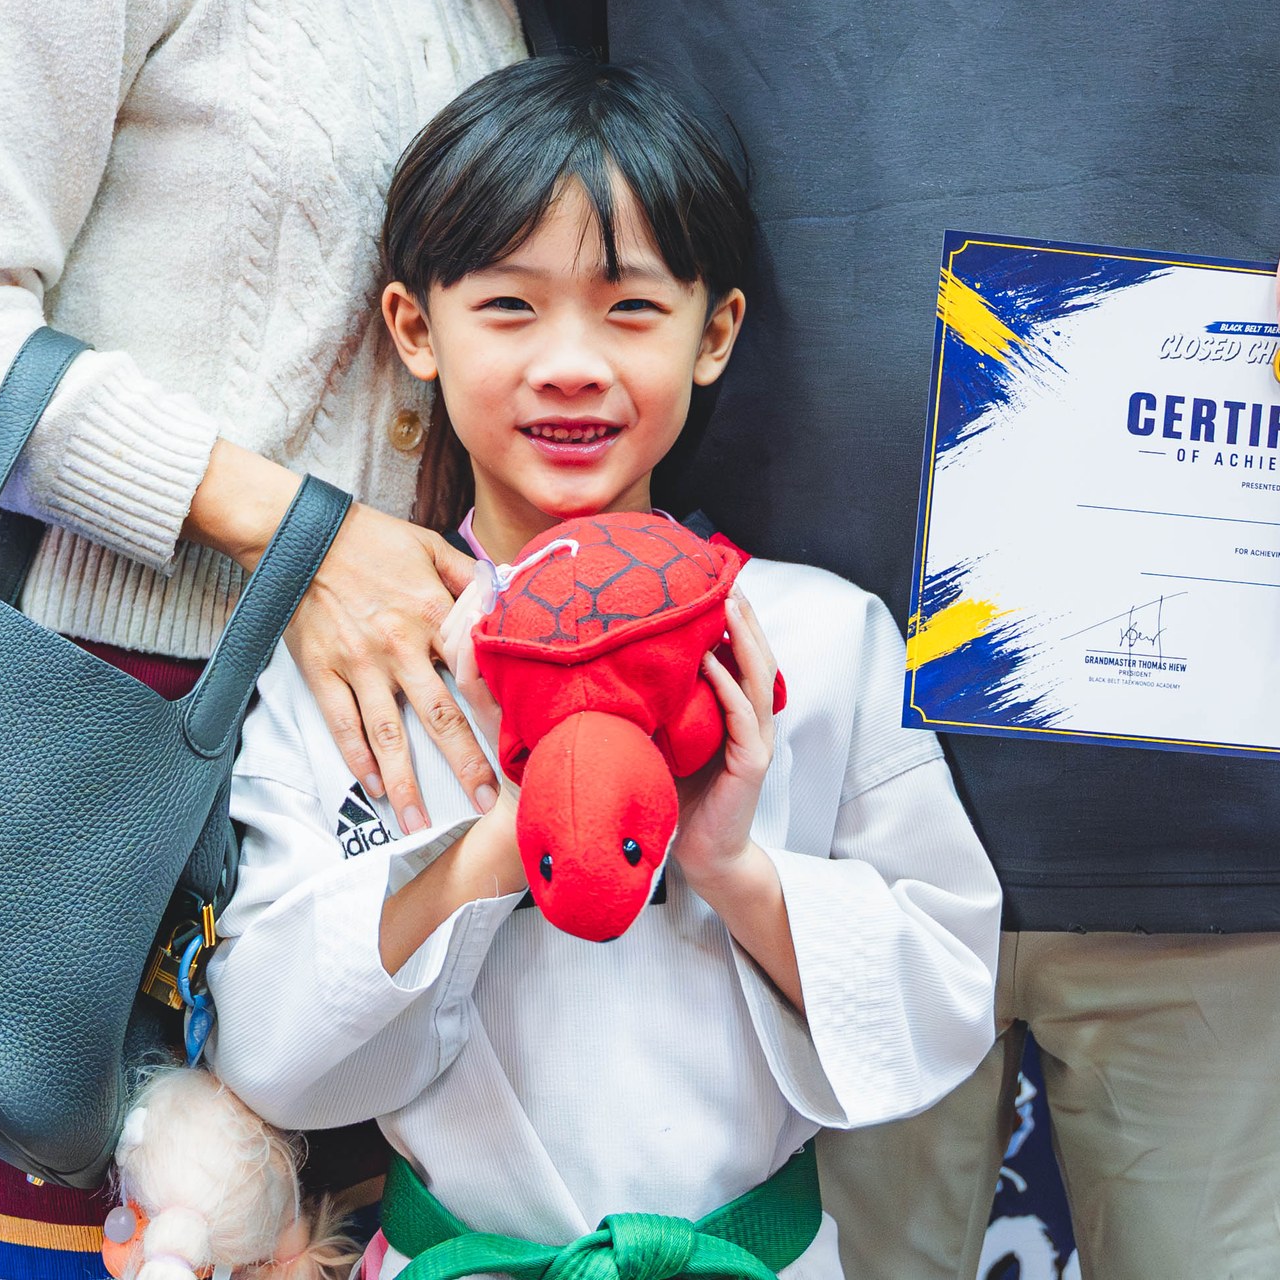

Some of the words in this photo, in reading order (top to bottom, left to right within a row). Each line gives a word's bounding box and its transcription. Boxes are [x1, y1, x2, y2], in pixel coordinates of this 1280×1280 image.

[1220, 323, 1242, 332] BLACK
[1244, 324, 1261, 333] BELT
[1159, 332, 1242, 362] CLOSED
[1176, 448, 1200, 464] OF
[1241, 481, 1280, 492] PRESENTED
[1234, 547, 1249, 555] FOR
[1084, 655, 1137, 668] GRANDMASTER
[1138, 660, 1167, 671] THOMAS
[1168, 663, 1187, 672] HIEW
[1118, 669, 1151, 678] PRESIDENT
[1107, 677, 1120, 685] BELT
[1121, 679, 1154, 688] TAEKWONDO
[1155, 681, 1181, 690] ACADEMY
